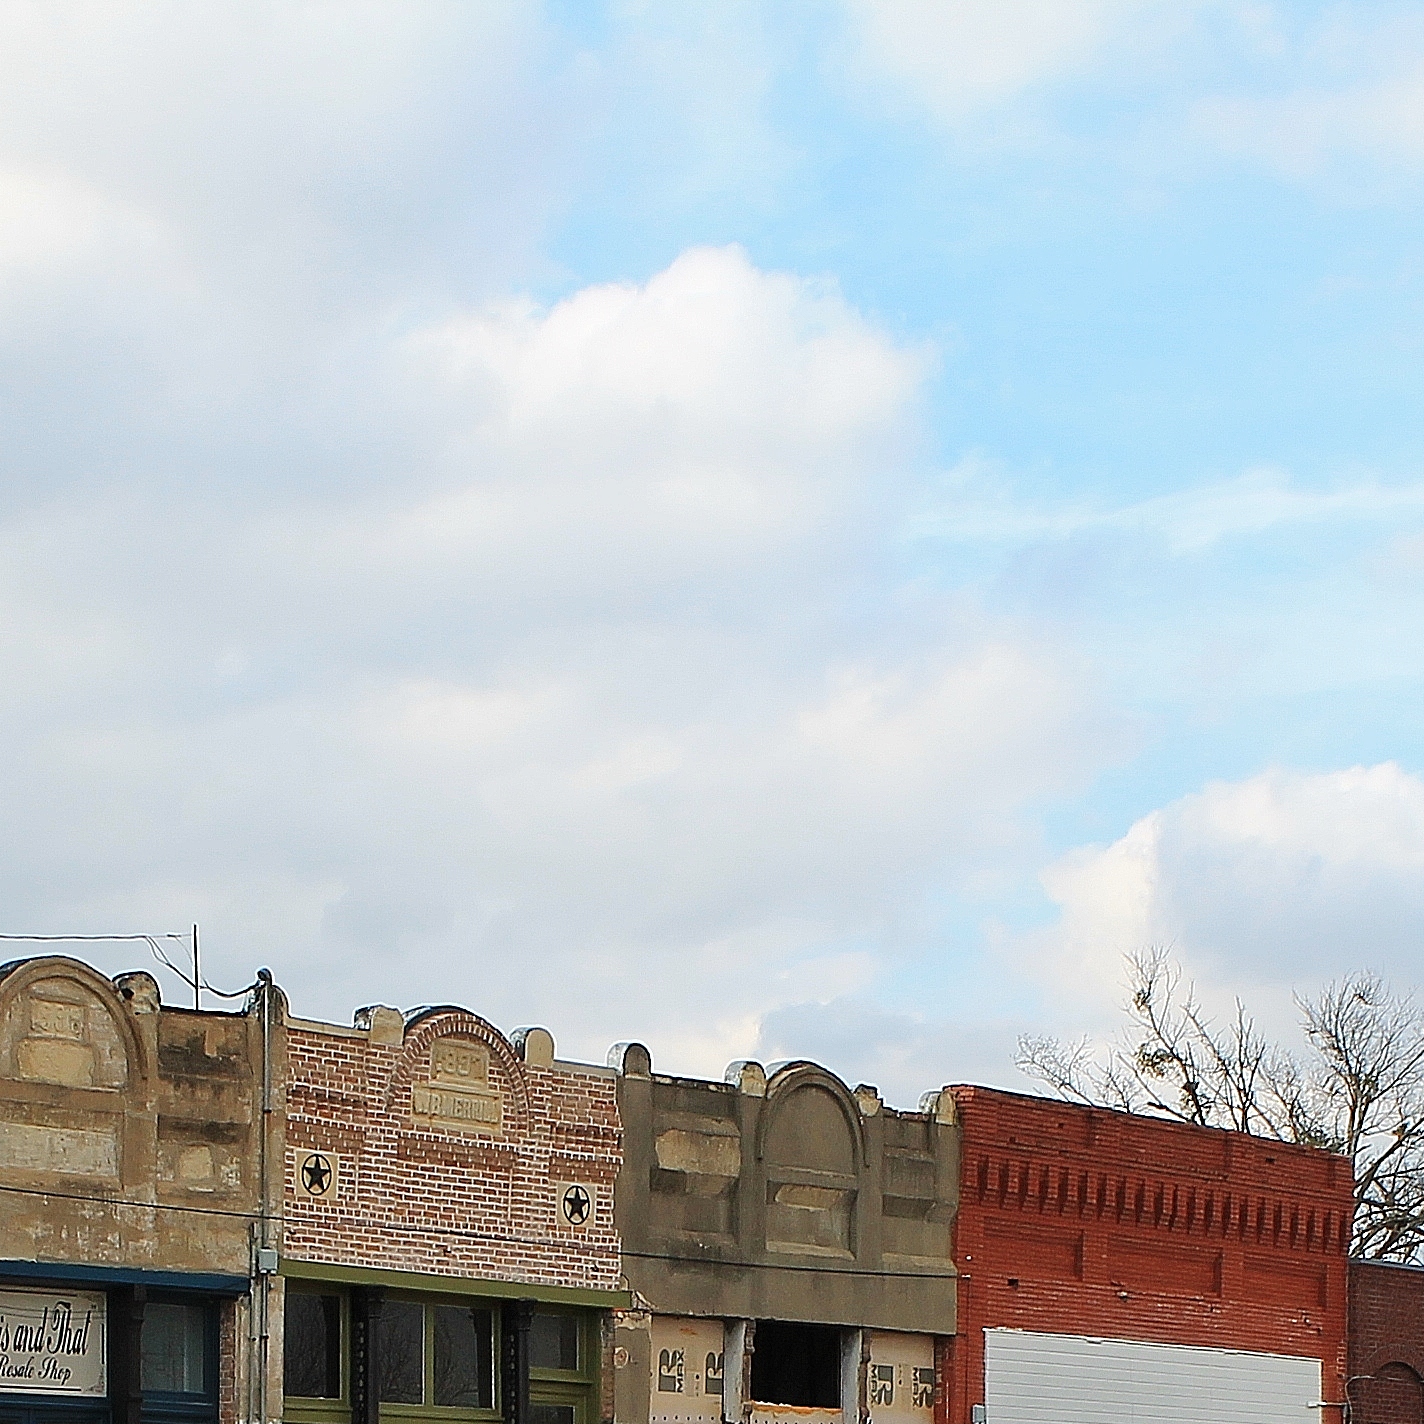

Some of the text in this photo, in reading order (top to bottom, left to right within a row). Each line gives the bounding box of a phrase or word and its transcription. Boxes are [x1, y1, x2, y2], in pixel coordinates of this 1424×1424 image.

[13, 1306, 49, 1353] and
[46, 1301, 92, 1355] That
[38, 1356, 72, 1386] Shop
[676, 1350, 685, 1393] MAX
[870, 1364, 878, 1404] MAX
